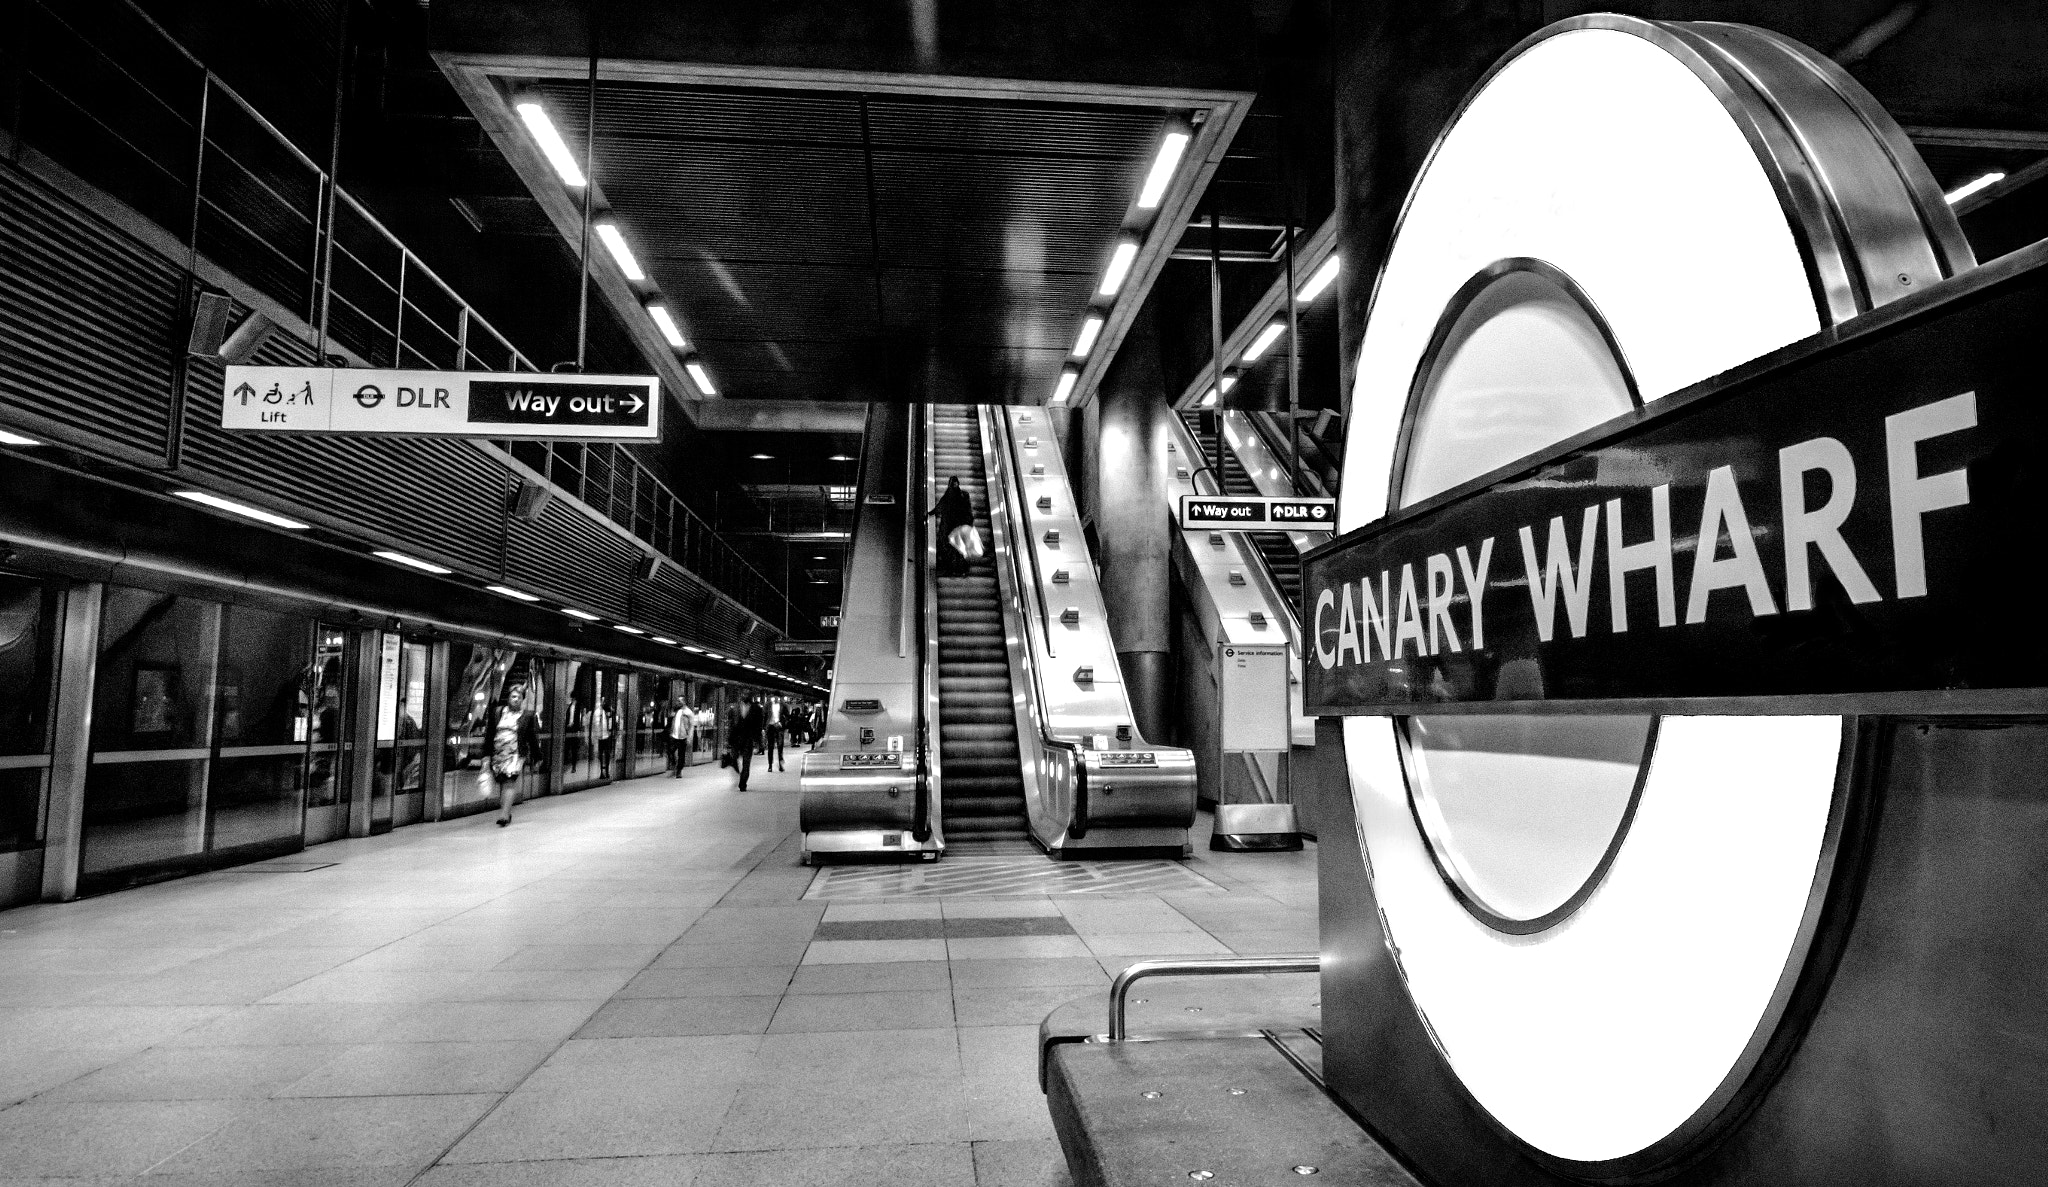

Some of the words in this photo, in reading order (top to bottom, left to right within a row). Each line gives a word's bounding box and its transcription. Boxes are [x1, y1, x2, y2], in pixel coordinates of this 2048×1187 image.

[396, 386, 451, 409] DLR
[505, 389, 560, 417] Way
[569, 397, 615, 413] out
[261, 411, 287, 423] Lift
[1202, 504, 1228, 518] Way
[1230, 506, 1252, 517] out
[1284, 506, 1308, 518] DLR
[1313, 536, 1495, 670] CANARY
[1518, 390, 1978, 643] WHARF
